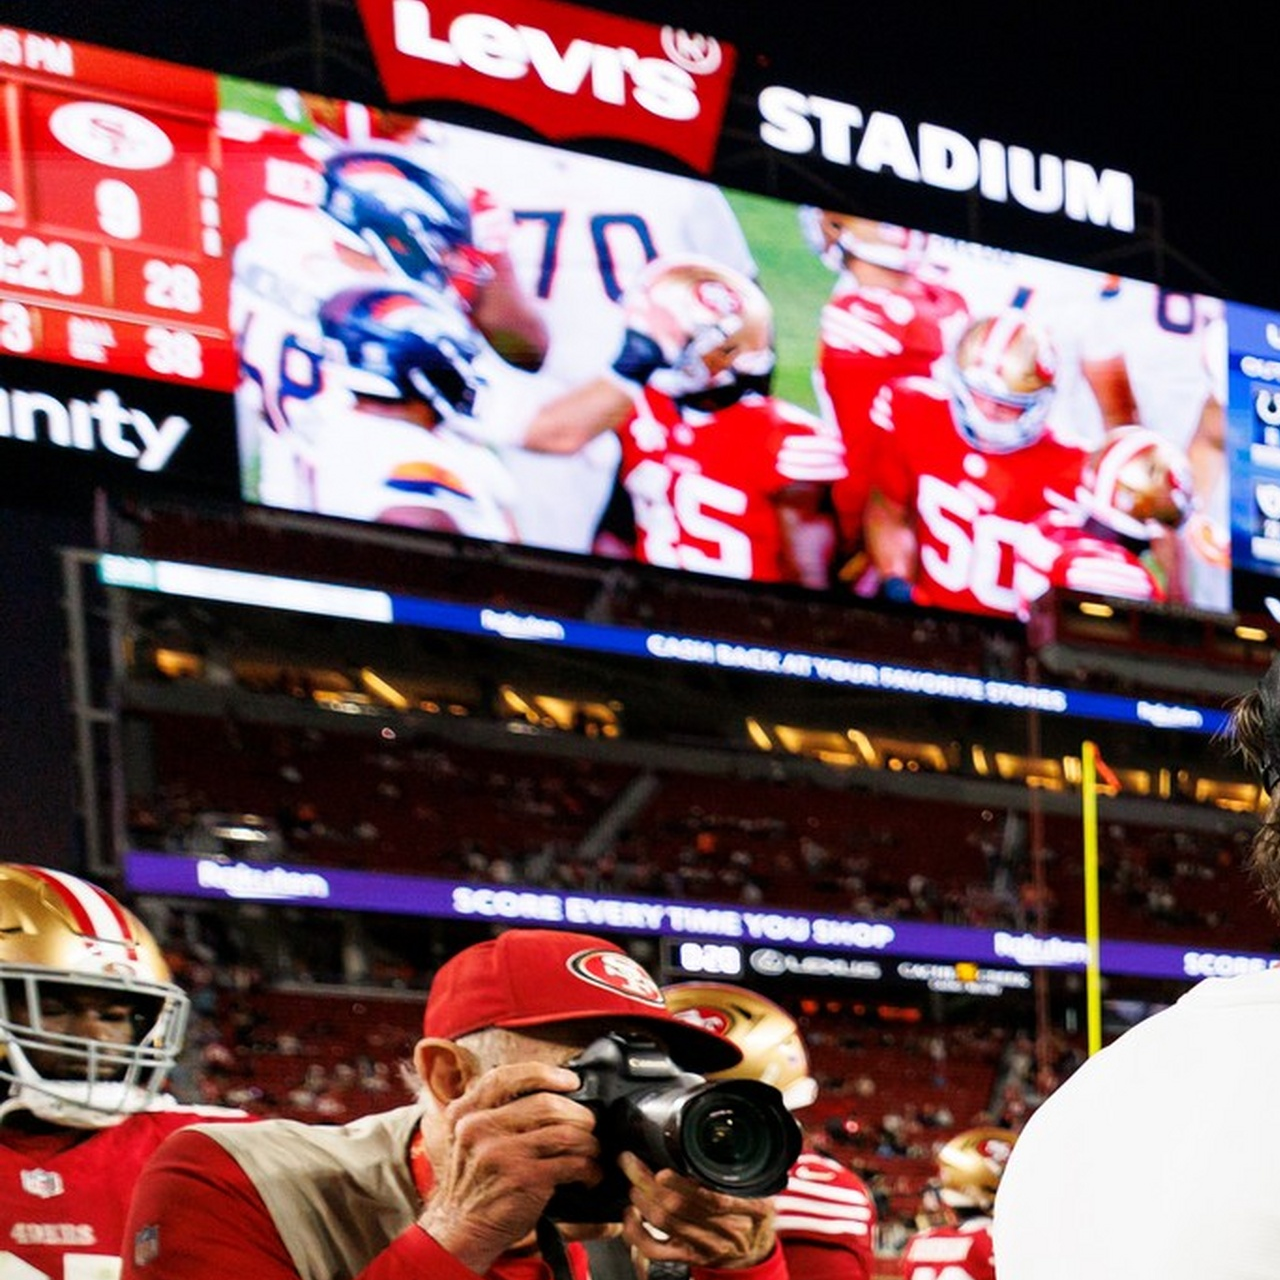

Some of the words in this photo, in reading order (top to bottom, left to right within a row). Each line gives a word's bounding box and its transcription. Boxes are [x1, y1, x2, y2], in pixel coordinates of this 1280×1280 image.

[758, 85, 1135, 233] STADIUM
[452, 887, 564, 921] SCORE
[565, 897, 664, 929] EVERY
[665, 905, 743, 936] TIME
[743, 912, 810, 942] YOU
[811, 919, 895, 949] SHOP
